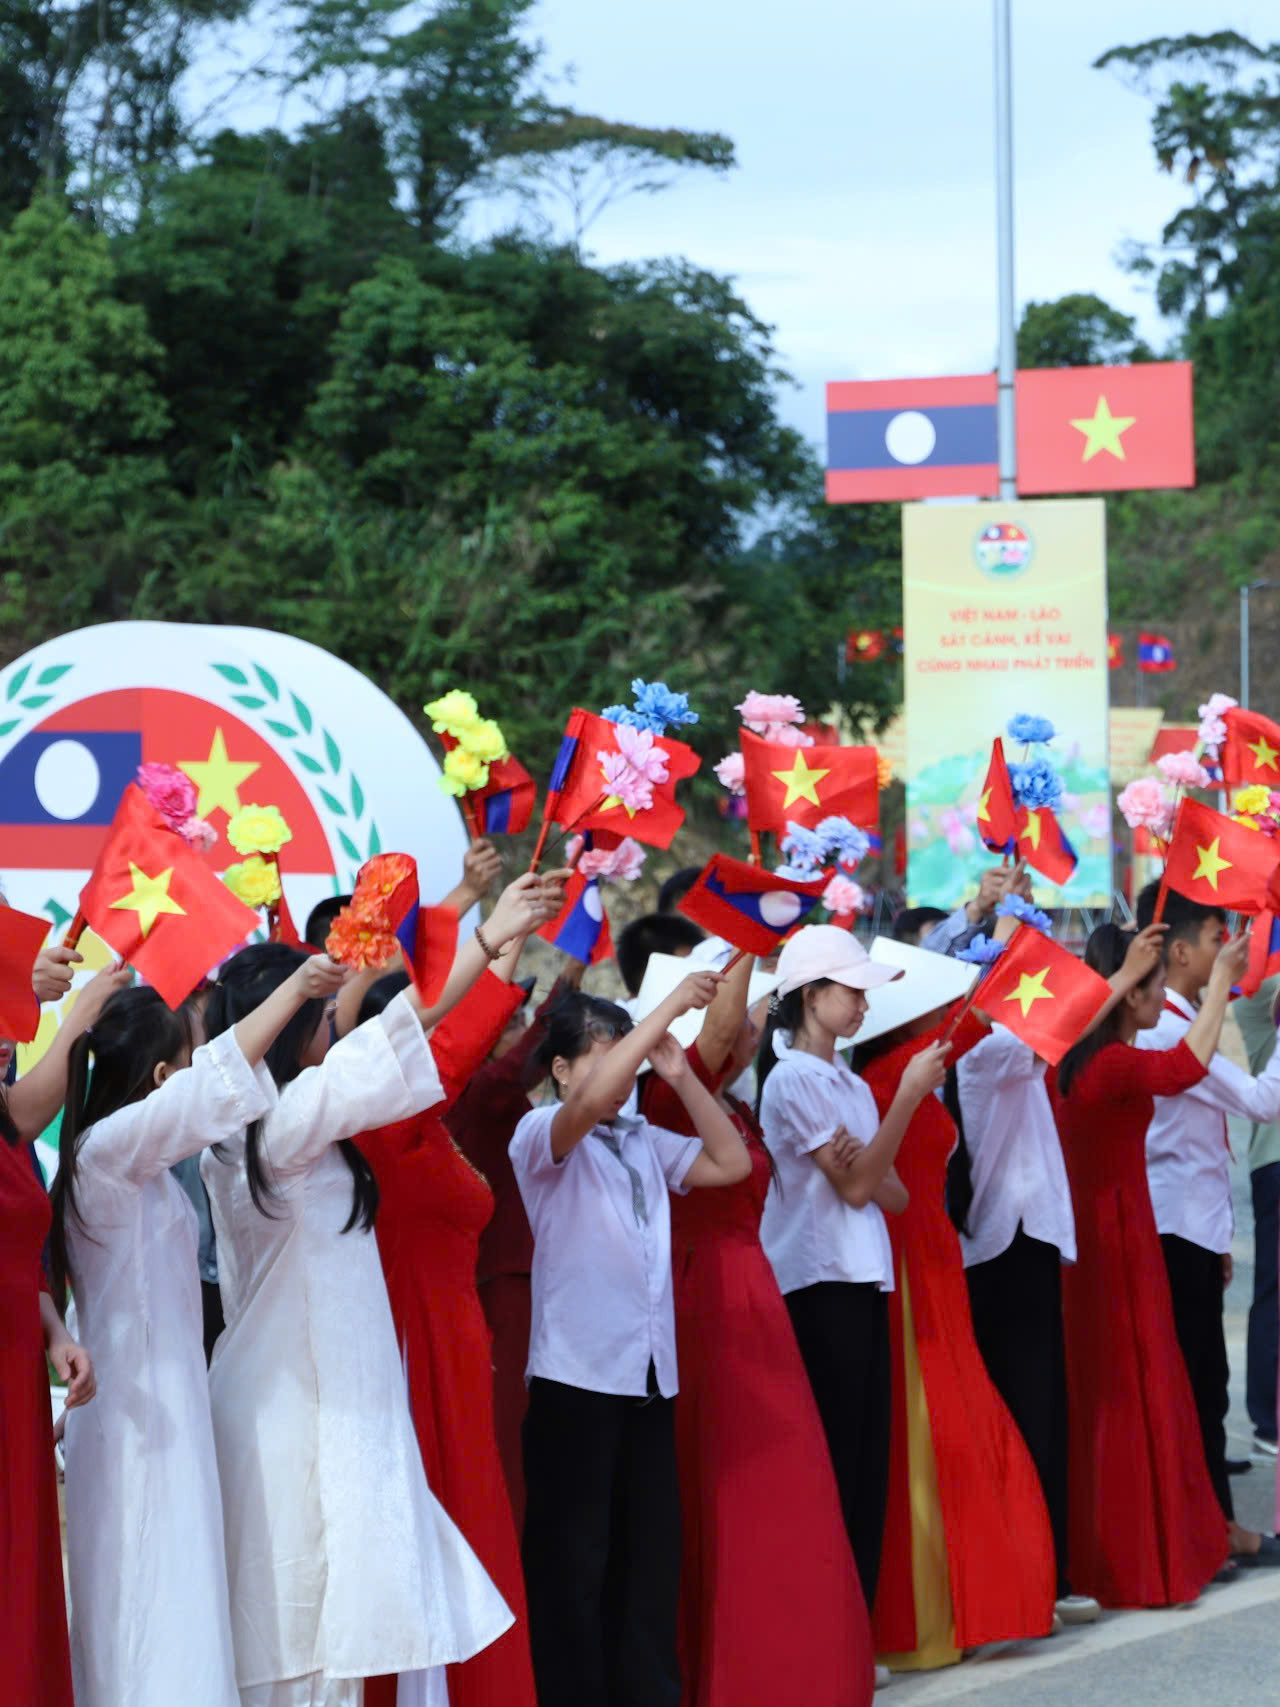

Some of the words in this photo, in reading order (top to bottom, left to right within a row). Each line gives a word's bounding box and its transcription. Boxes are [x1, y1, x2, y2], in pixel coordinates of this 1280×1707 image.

[950, 607, 979, 624] VIỆT
[982, 608, 1019, 622] NAM
[940, 631, 967, 648] SÁT
[1046, 632, 1072, 646] VAI
[966, 658, 1010, 671] NHAU
[1014, 653, 1051, 670] PHÁT
